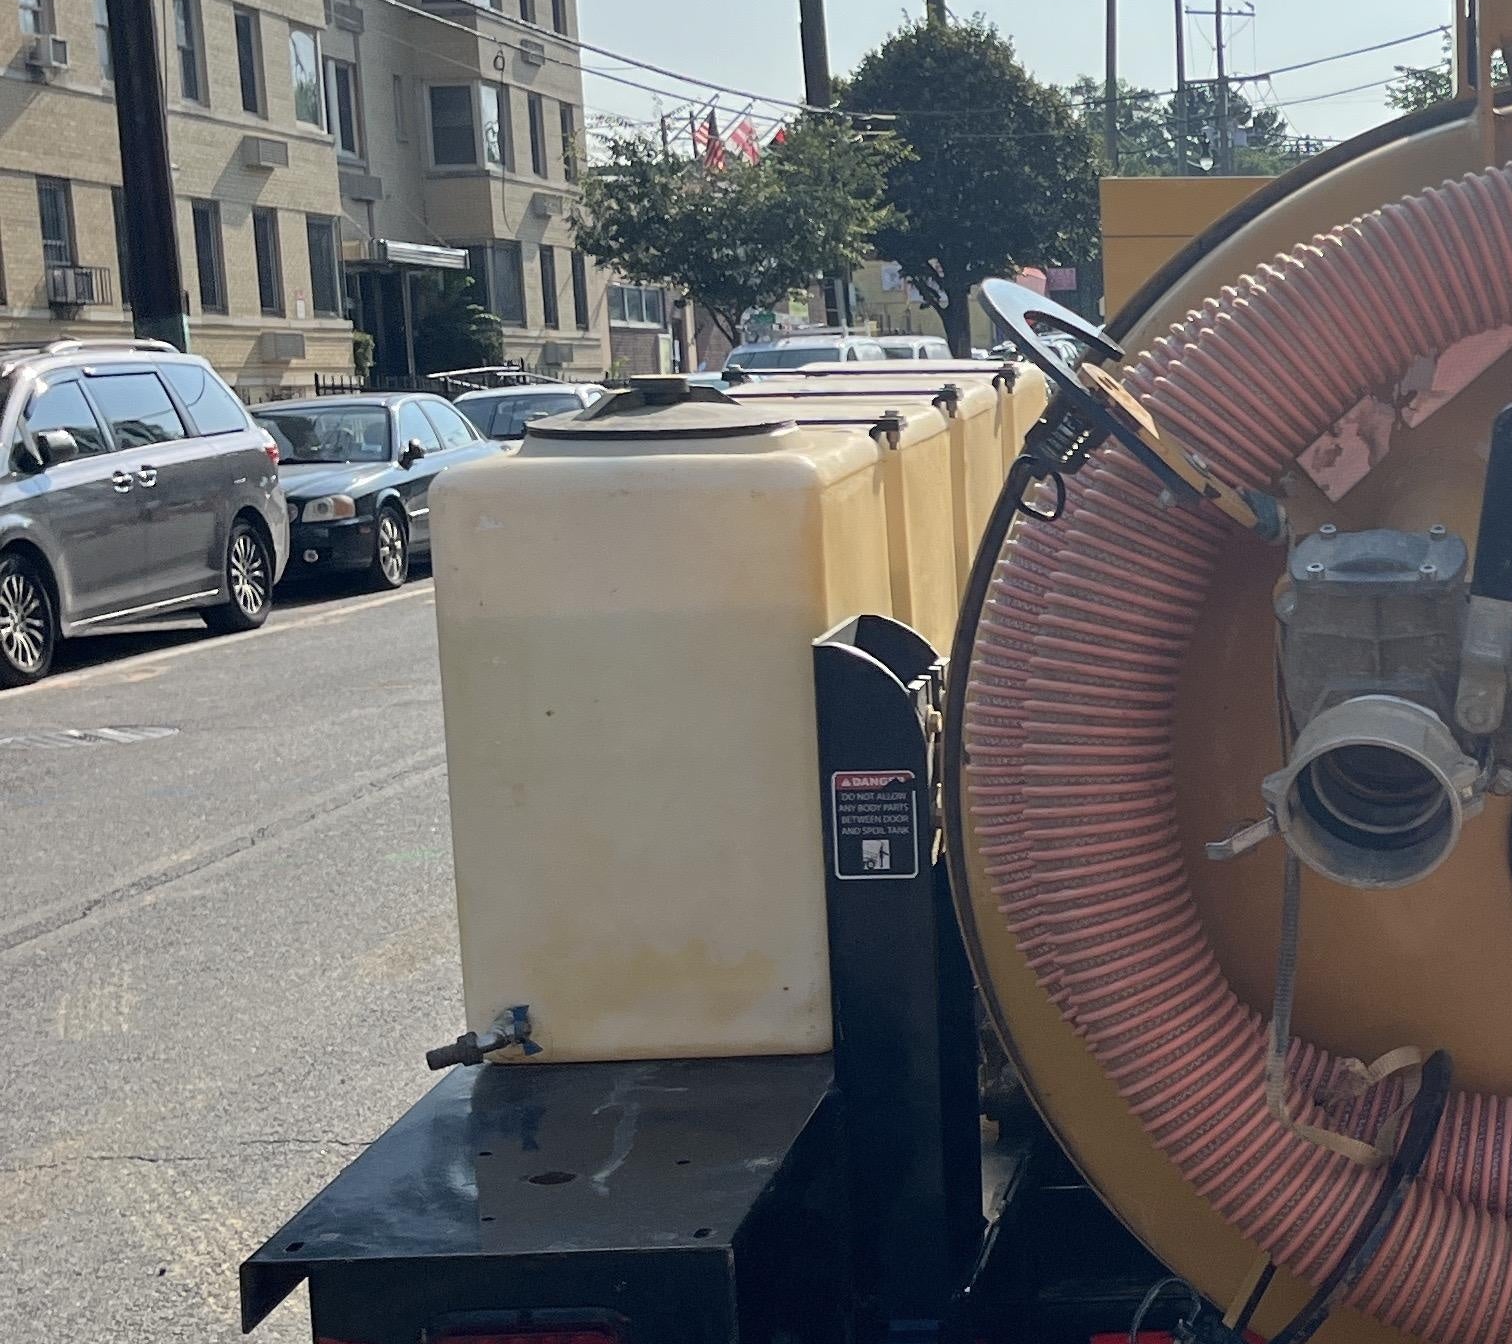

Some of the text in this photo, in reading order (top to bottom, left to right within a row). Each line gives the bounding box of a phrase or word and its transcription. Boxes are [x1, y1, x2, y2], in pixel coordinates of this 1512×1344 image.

[841, 791, 907, 801] DO NOT ALLOW
[839, 802, 910, 812] ANY BODY PARTS
[841, 814, 910, 824] BETWEEN DOOR
[841, 826, 910, 835] AND SPOIL TANK
